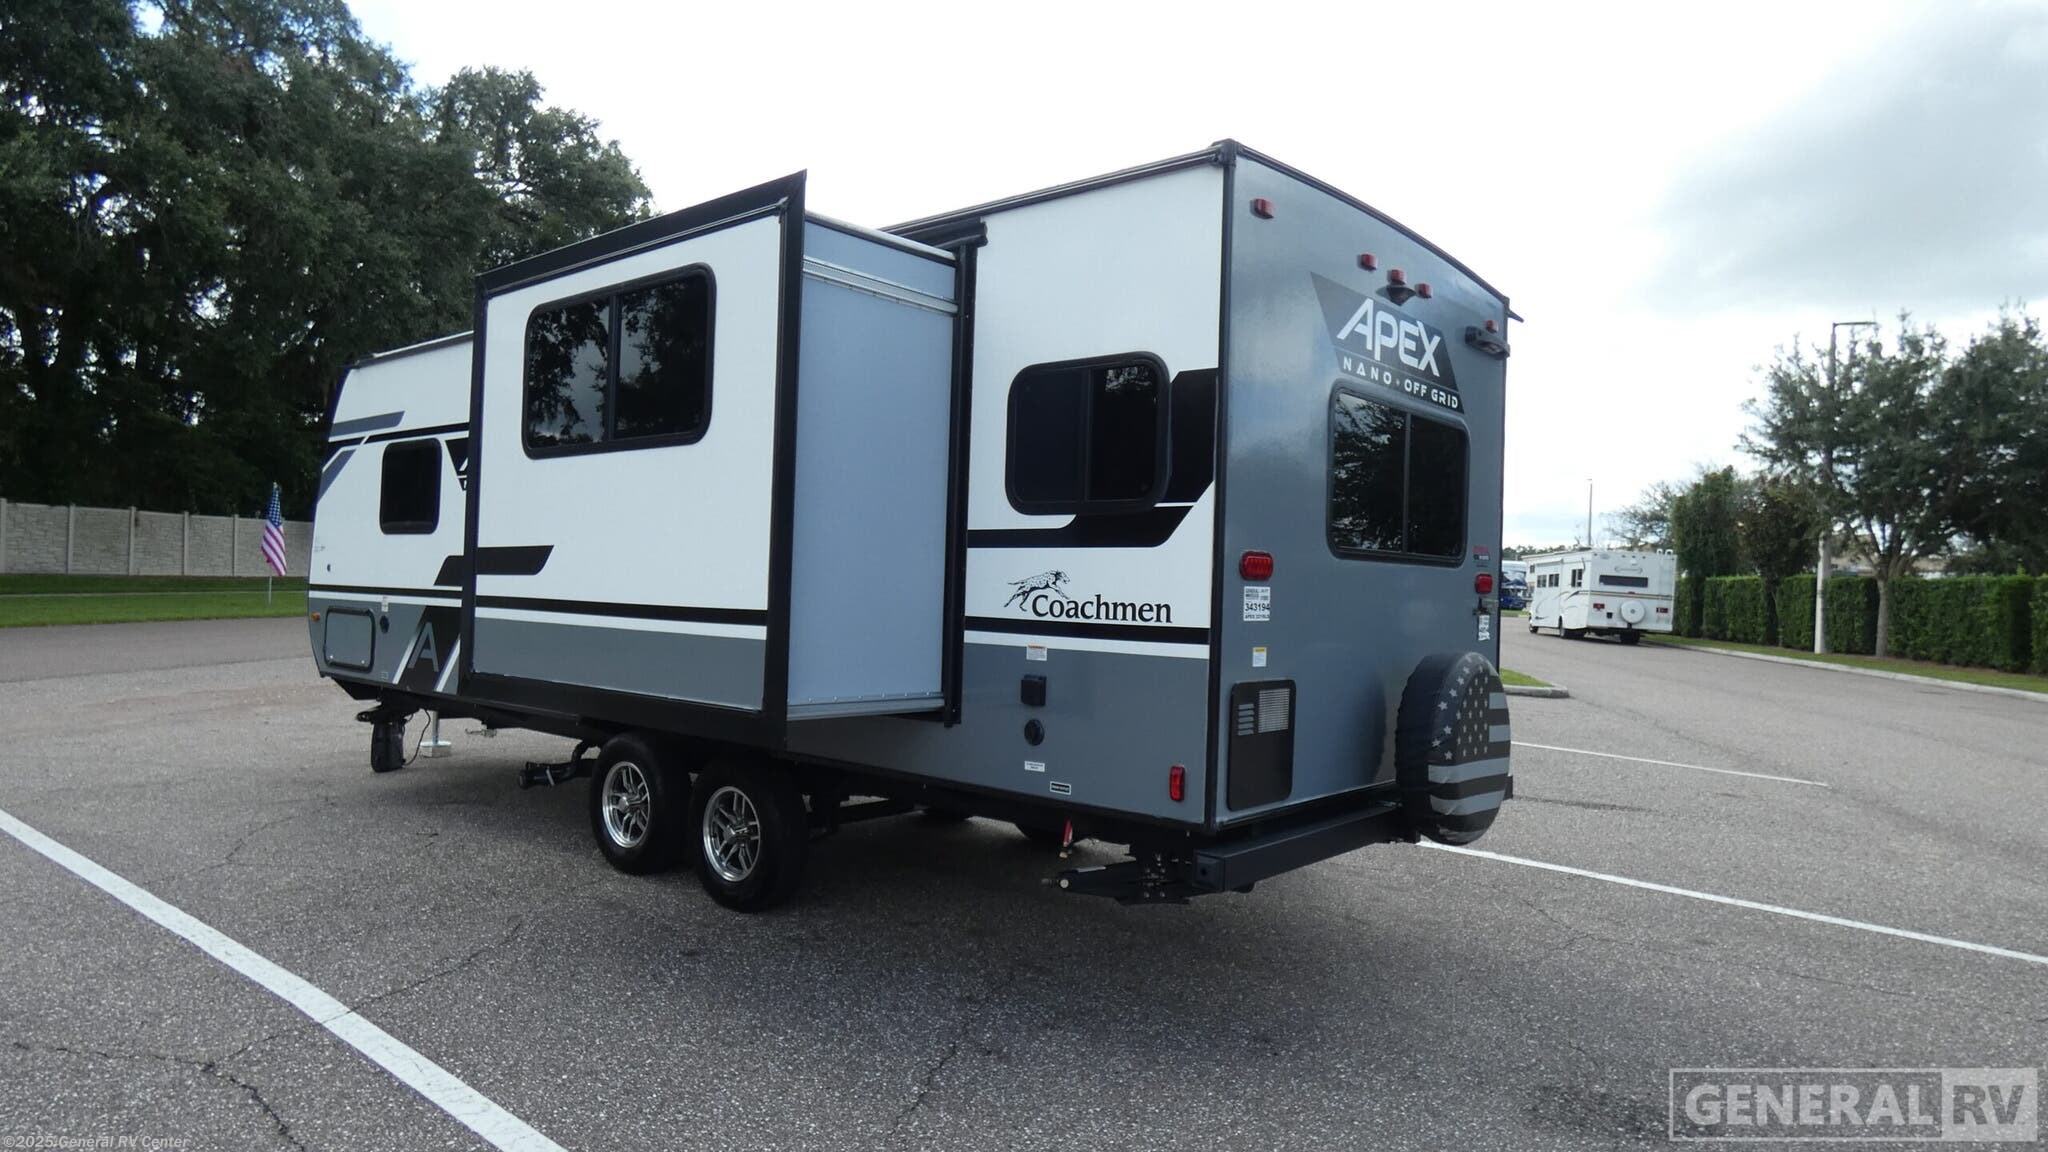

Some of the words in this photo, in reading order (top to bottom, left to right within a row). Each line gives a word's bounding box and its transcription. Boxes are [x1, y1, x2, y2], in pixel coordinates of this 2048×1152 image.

[1337, 298, 1441, 377] APEX
[1343, 356, 1392, 385] NANO
[1404, 379, 1428, 397] OFF
[1431, 389, 1459, 409] GRID
[1032, 594, 1172, 623] Coachmen
[1245, 602, 1270, 611] 343194
